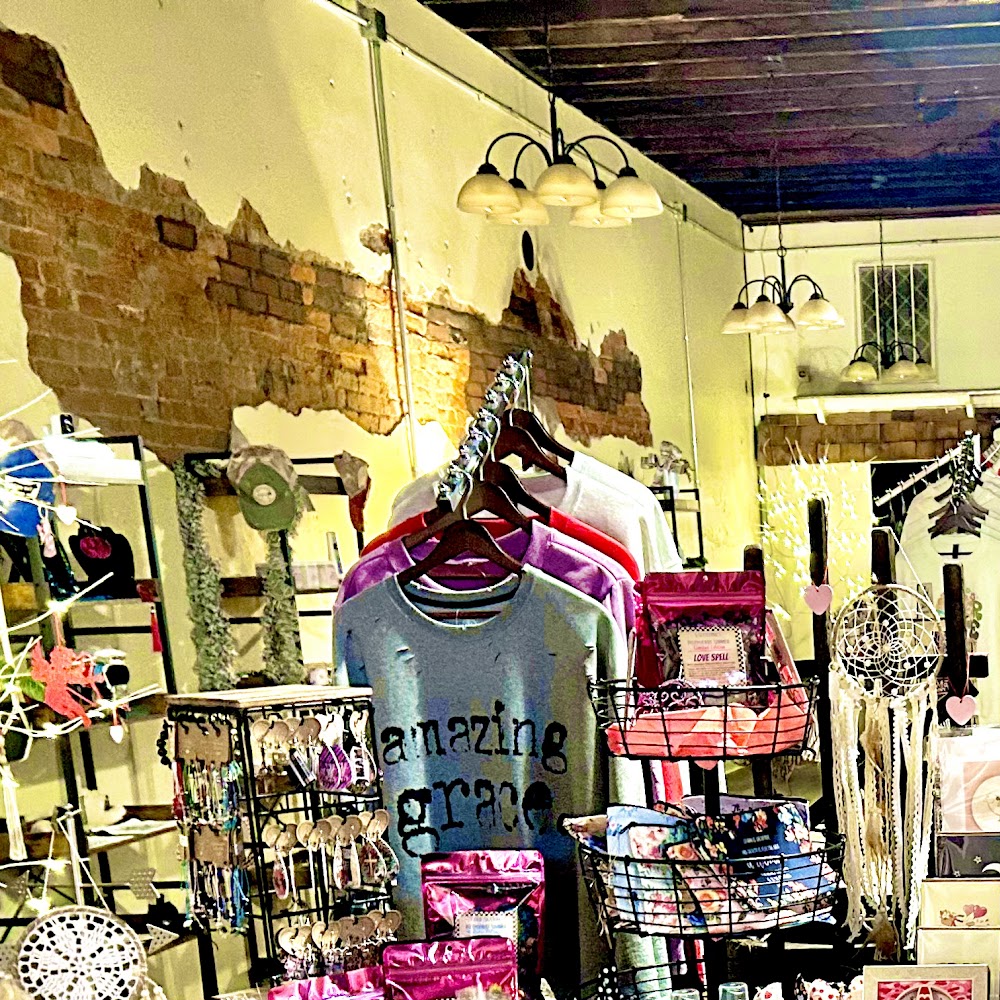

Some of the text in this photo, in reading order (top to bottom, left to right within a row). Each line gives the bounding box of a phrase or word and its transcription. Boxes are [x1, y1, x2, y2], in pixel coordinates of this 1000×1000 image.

[693, 652, 729, 662] LOVE SPELL
[380, 700, 568, 774] amazing
